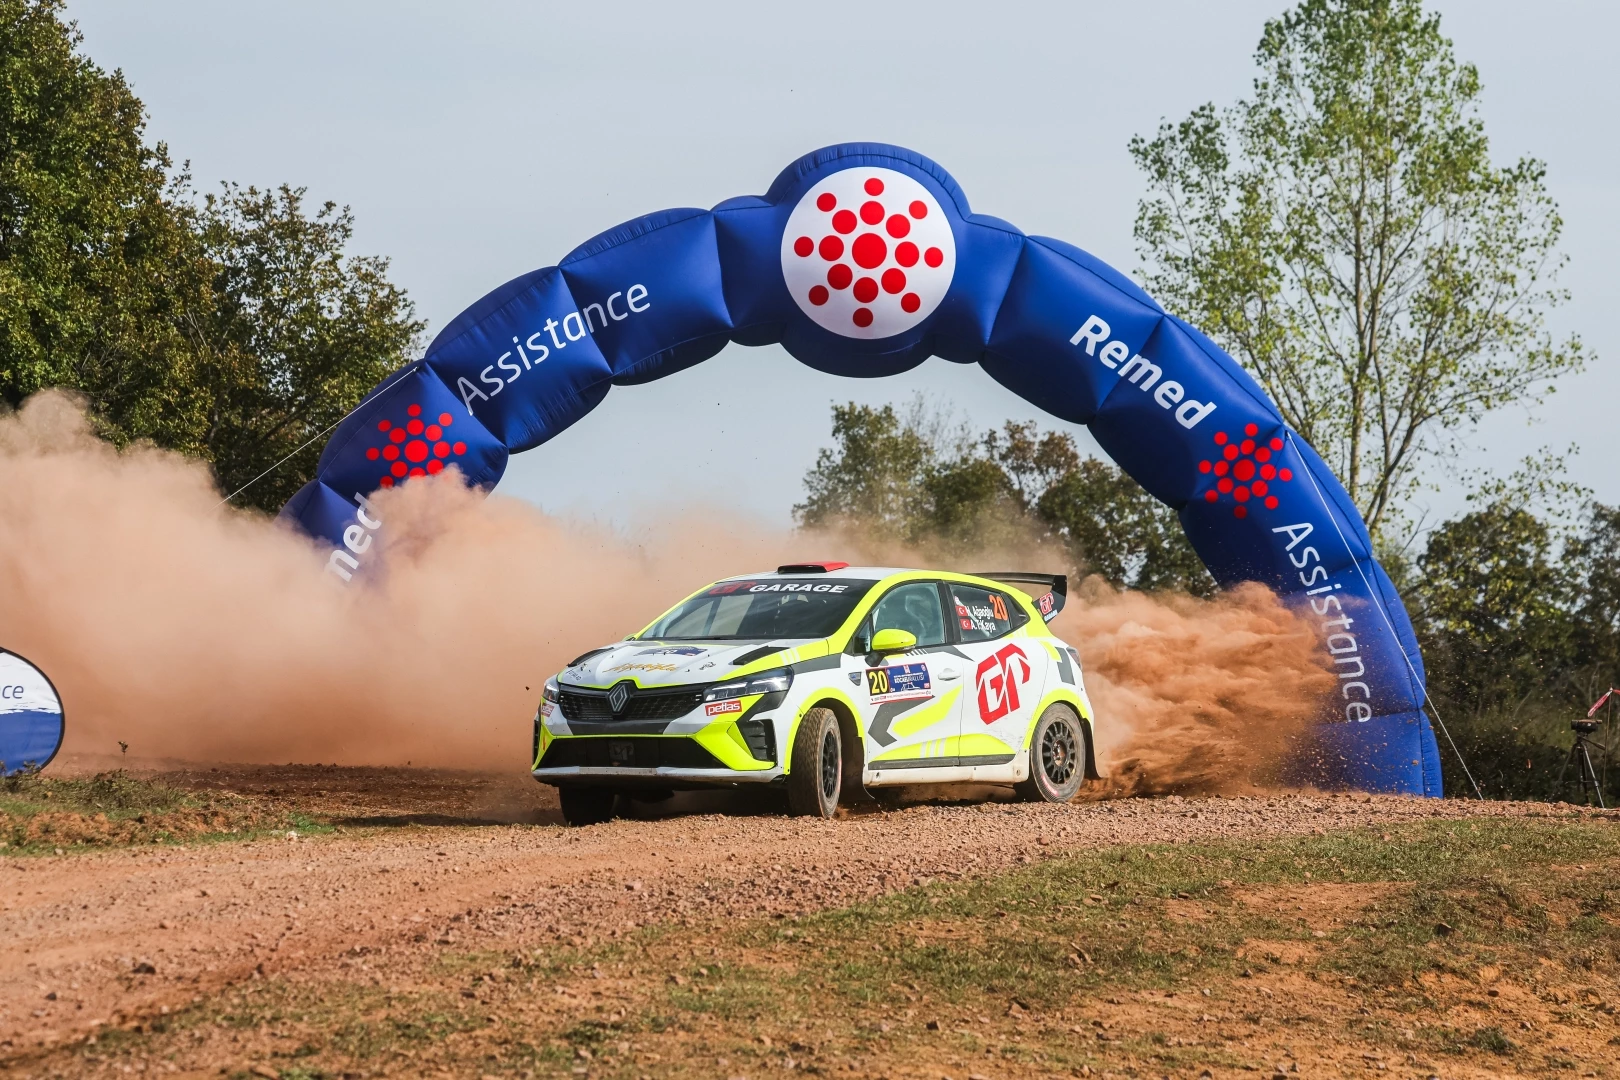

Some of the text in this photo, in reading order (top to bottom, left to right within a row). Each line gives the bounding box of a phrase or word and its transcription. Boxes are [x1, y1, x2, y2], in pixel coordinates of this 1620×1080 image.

[457, 283, 651, 417] Assistance
[1069, 314, 1217, 430] Remed
[322, 491, 383, 583] med
[749, 583, 849, 594] GARAGE
[988, 594, 1008, 621] 20
[1271, 522, 1372, 723] Assistance
[0, 685, 24, 699] ce
[868, 670, 888, 694] 20
[707, 702, 741, 716] petlas
